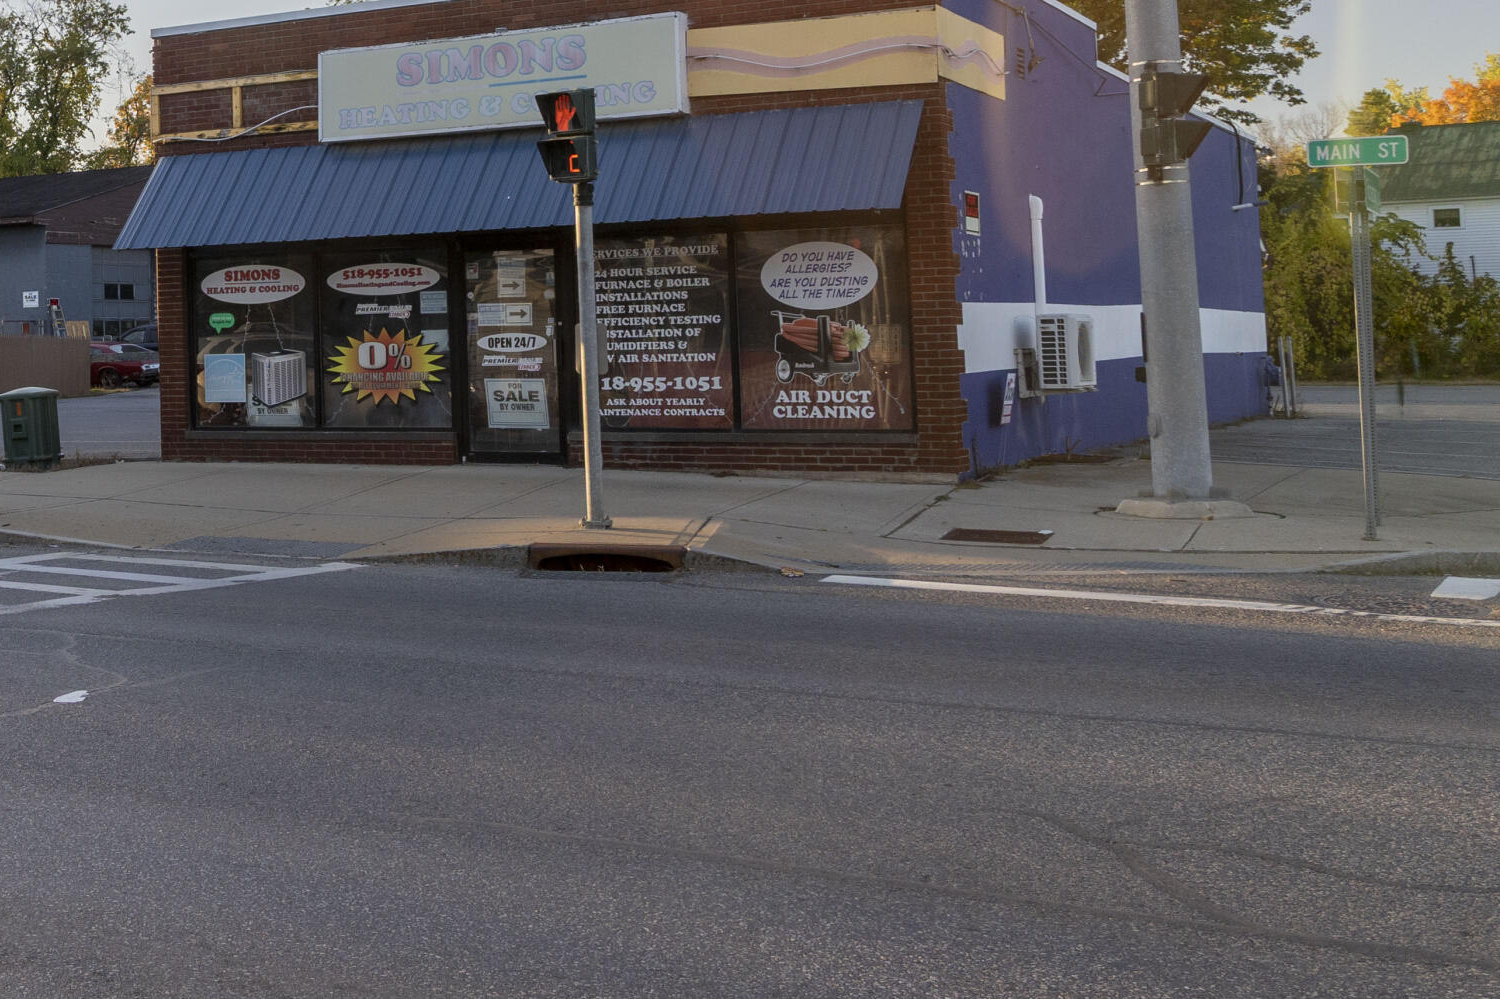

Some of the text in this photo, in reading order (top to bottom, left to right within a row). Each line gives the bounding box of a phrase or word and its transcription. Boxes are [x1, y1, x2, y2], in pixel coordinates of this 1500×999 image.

[396, 34, 587, 87] SIMONS
[338, 96, 470, 130] HEATING
[478, 95, 503, 117] &
[1316, 142, 1399, 160] MAIN ST
[642, 246, 661, 256] WE
[664, 244, 719, 255] PROVIDE
[782, 250, 854, 262] DO YOU HAVE
[342, 267, 423, 280] 518-955-1051
[646, 265, 697, 276] SERVICE
[785, 263, 852, 274] ALLERGIES?
[224, 268, 280, 282] SIMONS
[595, 280, 651, 290] FURNACE
[666, 277, 711, 287] BOILER
[770, 276, 869, 288] ARE YOU DUSTING
[206, 286, 247, 295] HEATING
[258, 284, 300, 293] COOLING
[778, 287, 860, 299] ALL THE TIME?
[596, 290, 689, 302] INSTALLATIONS
[596, 303, 686, 314] FREE FURNACE
[668, 314, 722, 325] TESTING
[685, 328, 702, 337] OF
[487, 336, 537, 348] OPEN 24/7
[606, 341, 688, 350] UMIDIFIERS &
[358, 341, 413, 370] 0%
[618, 354, 639, 363] AIR
[642, 353, 717, 363] SANITATION
[601, 376, 723, 392] 18-955-1051
[493, 390, 540, 402] SALE
[606, 398, 706, 406] ASK ABOUT YEARLY
[775, 390, 872, 403] AIR DUCT
[510, 403, 535, 411] OWNER
[599, 408, 726, 416] AINTENANCE CONTRACTS
[772, 405, 876, 419] CLEANING
